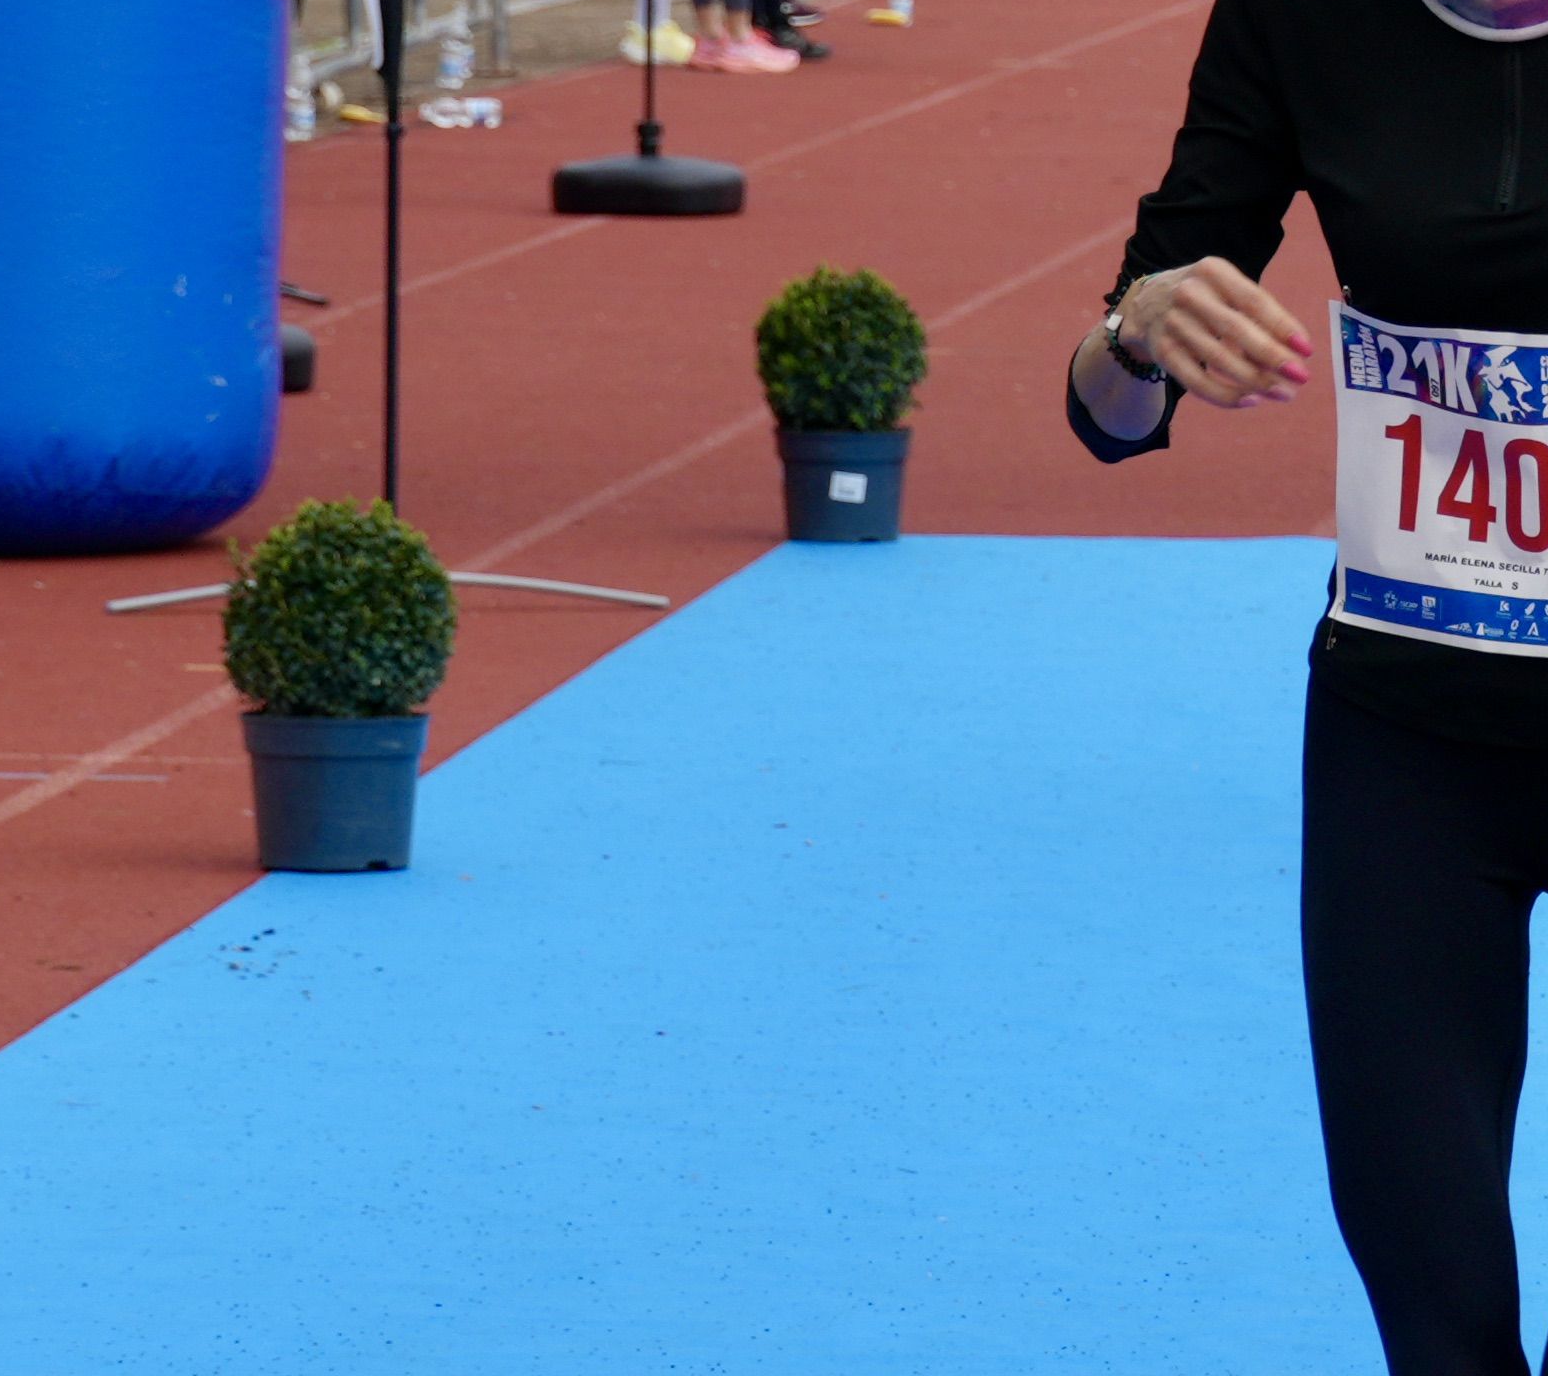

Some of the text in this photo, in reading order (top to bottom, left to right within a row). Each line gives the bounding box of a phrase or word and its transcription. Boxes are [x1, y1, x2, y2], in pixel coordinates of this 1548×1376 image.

[1376, 333, 1479, 414] 21K
[1424, 552, 1458, 565] MARÍA
[1461, 557, 1495, 570] ELENA
[1498, 562, 1541, 575] SECILLA
[1474, 578, 1519, 591] TALLA S
